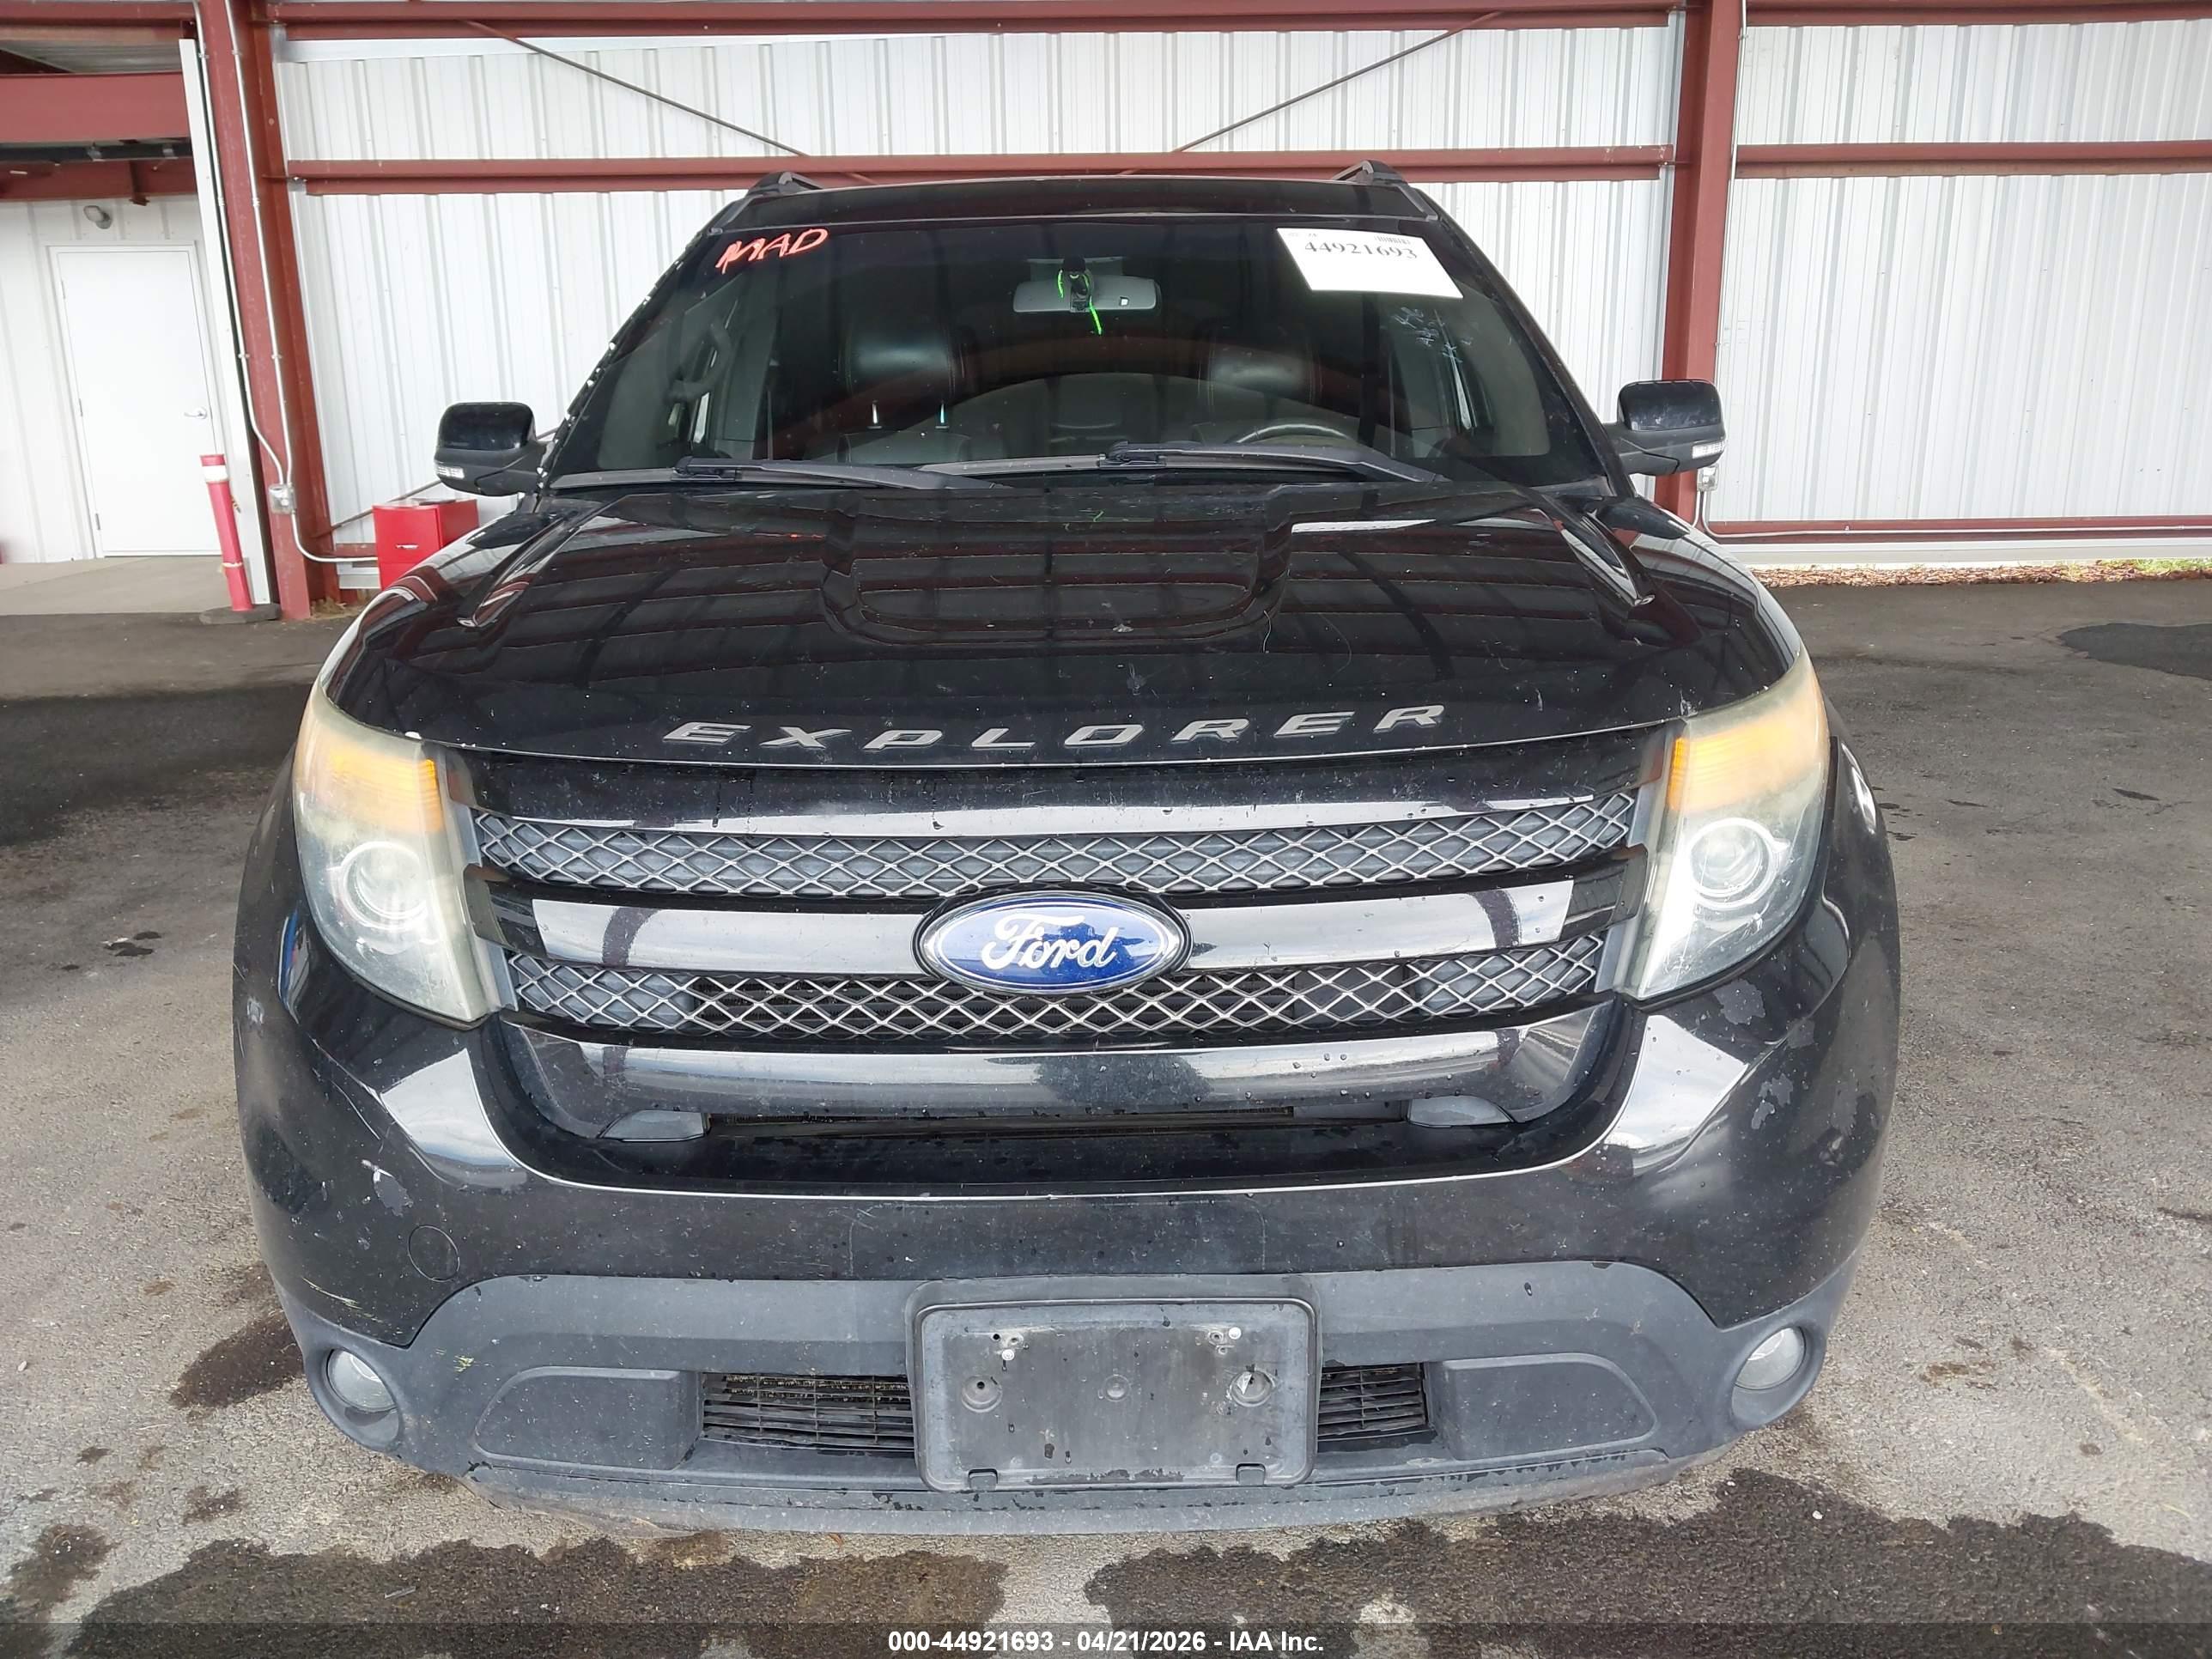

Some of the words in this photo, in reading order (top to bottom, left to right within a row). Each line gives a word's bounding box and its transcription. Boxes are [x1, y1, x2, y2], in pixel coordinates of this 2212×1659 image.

[1304, 241, 1418, 259] 44921693
[663, 704, 1445, 751] EXPLORER
[981, 913, 1120, 970] Ford
